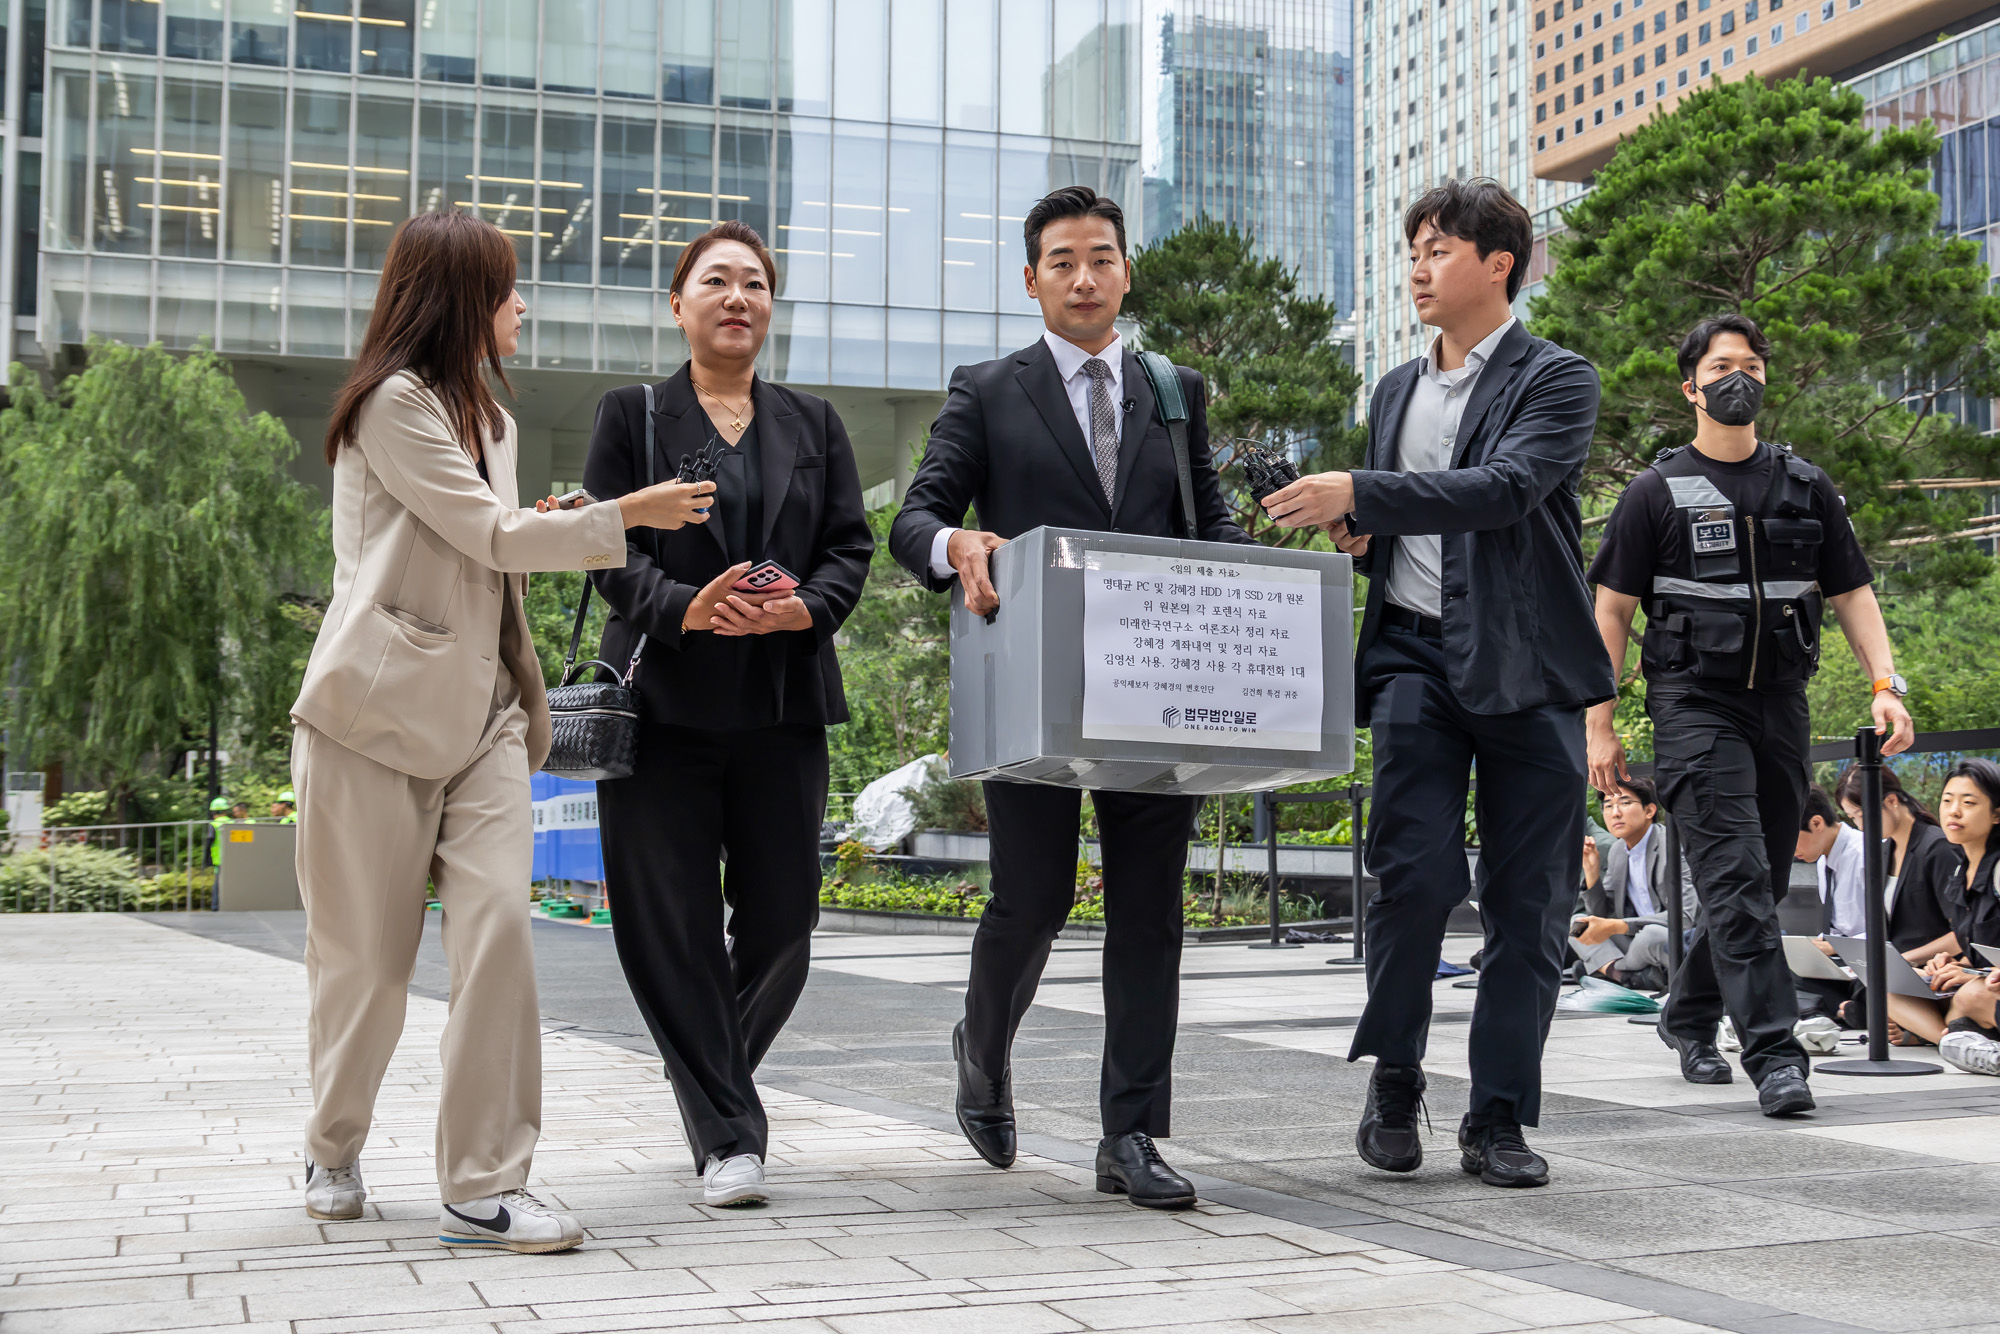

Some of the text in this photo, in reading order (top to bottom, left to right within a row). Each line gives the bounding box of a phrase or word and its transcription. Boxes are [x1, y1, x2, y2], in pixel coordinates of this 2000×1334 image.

[1699, 526, 1728, 538] 보안
[1170, 564, 1241, 578] <임의 제출 자료>
[1103, 578, 1304, 605] 명태균 PC 및 강혜경 HDD 1개 SSD 2개 원본
[1143, 600, 1267, 619] 위 원본의 각 포렌식 자료
[1119, 617, 1290, 639] 미래한국연구소 여론조사 정리 자료
[1133, 637, 1278, 657] 강혜경 계좌내역 및 정리 자료
[1103, 653, 1135, 667] 김영선
[1170, 657, 1200, 671] 강혜경
[1206, 660, 1226, 673] 사용
[1231, 662, 1241, 674] 각
[1246, 662, 1285, 677] 휴대전화
[1290, 666, 1306, 678] 1대
[1112, 678, 1149, 690] 공익제보자
[1153, 681, 1182, 692] 강혜경의
[1242, 687, 1299, 700] 김건희 특검 귀중
[1184, 708, 1257, 725] 법무법인일로
[1184, 723, 1200, 731] ONE
[1203, 724, 1225, 732] ROAD
